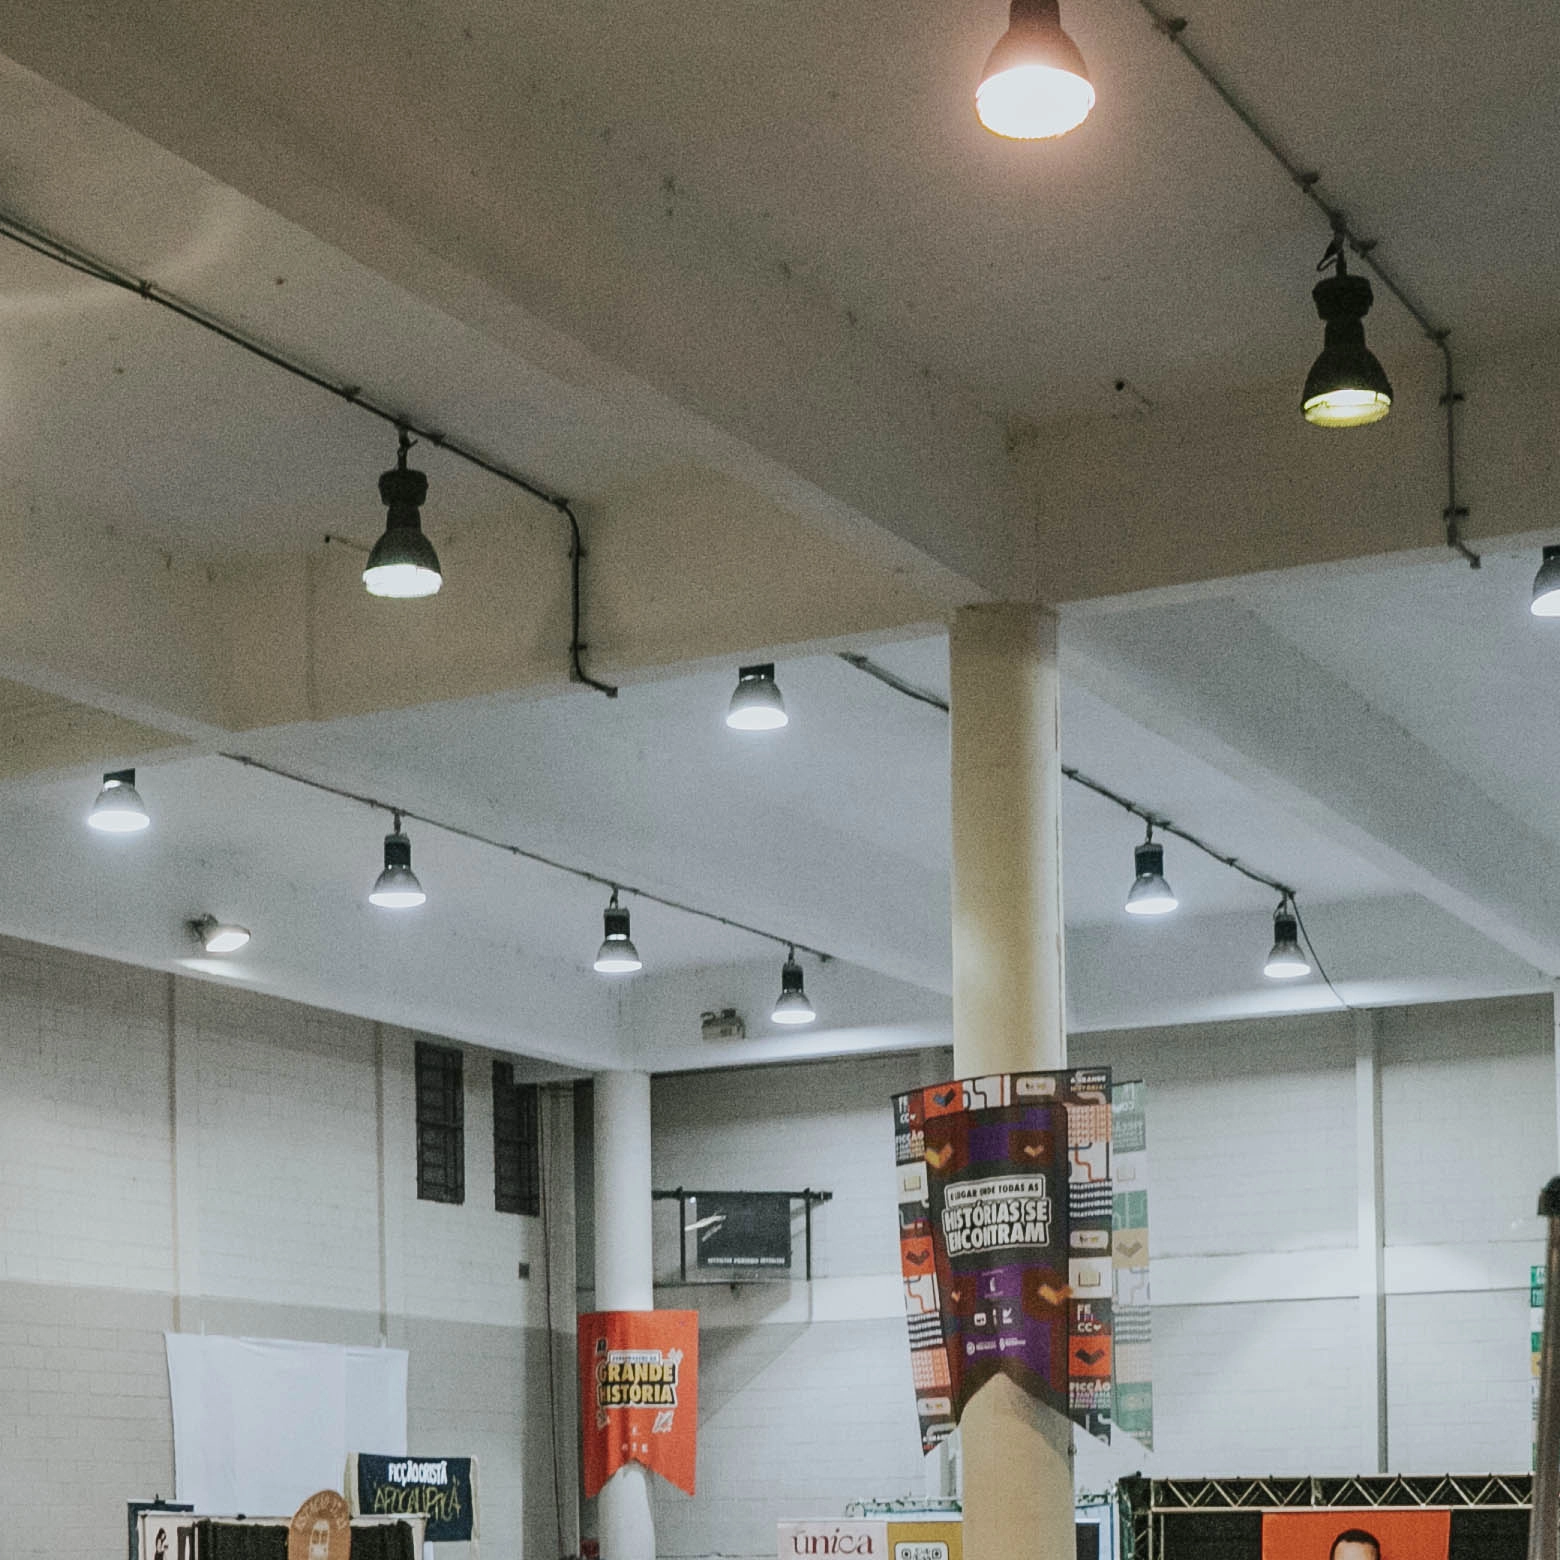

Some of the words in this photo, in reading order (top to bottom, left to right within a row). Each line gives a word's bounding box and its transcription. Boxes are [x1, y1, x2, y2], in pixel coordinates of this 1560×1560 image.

[999, 1183, 1025, 1193] TODAS
[1028, 1183, 1039, 1192] AS
[944, 1199, 1021, 1232] HISTÓRIAS
[1025, 1200, 1047, 1221] SE
[598, 1362, 674, 1383] GRANDE
[600, 1381, 673, 1404] HISTÓRIA
[388, 1459, 419, 1488] FICÇÃO
[420, 1460, 448, 1486] CRISTÃ
